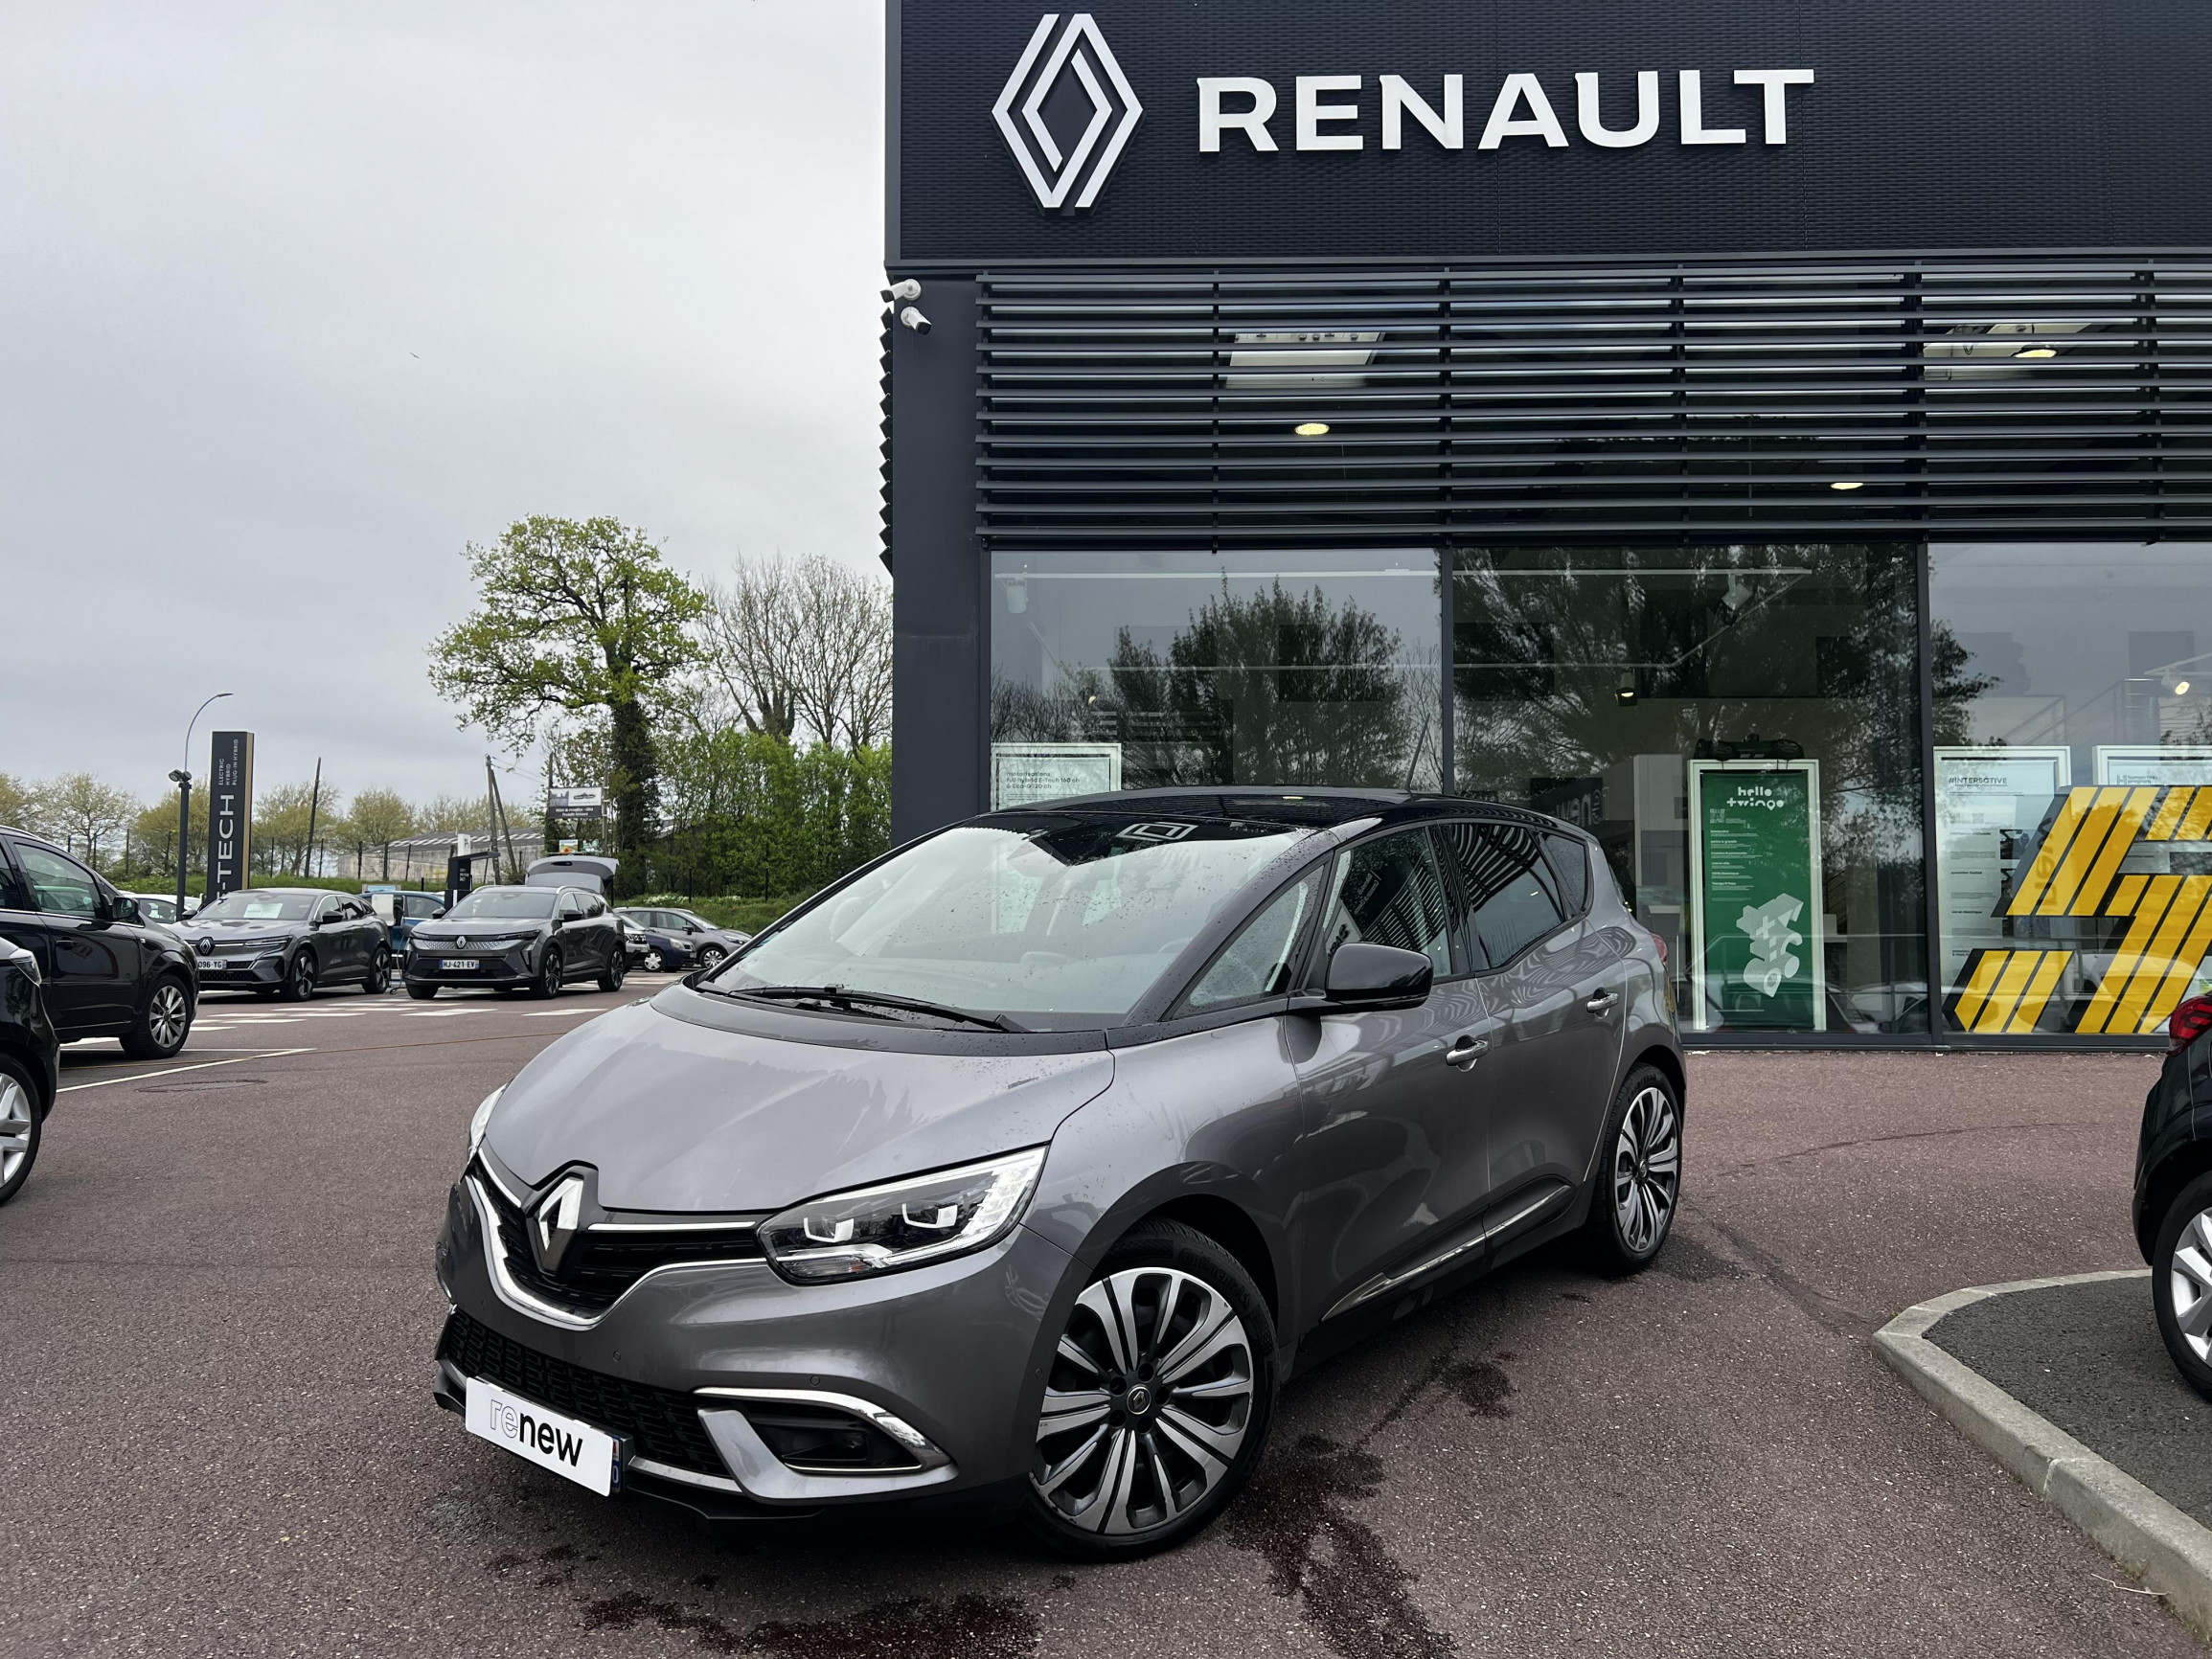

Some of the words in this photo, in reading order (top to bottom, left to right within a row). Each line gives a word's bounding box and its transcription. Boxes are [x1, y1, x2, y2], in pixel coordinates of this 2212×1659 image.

[1197, 69, 1814, 152] RENAULT
[1738, 785, 1772, 797] hello
[217, 794, 235, 899] -TECH
[490, 1399, 583, 1467] renew
